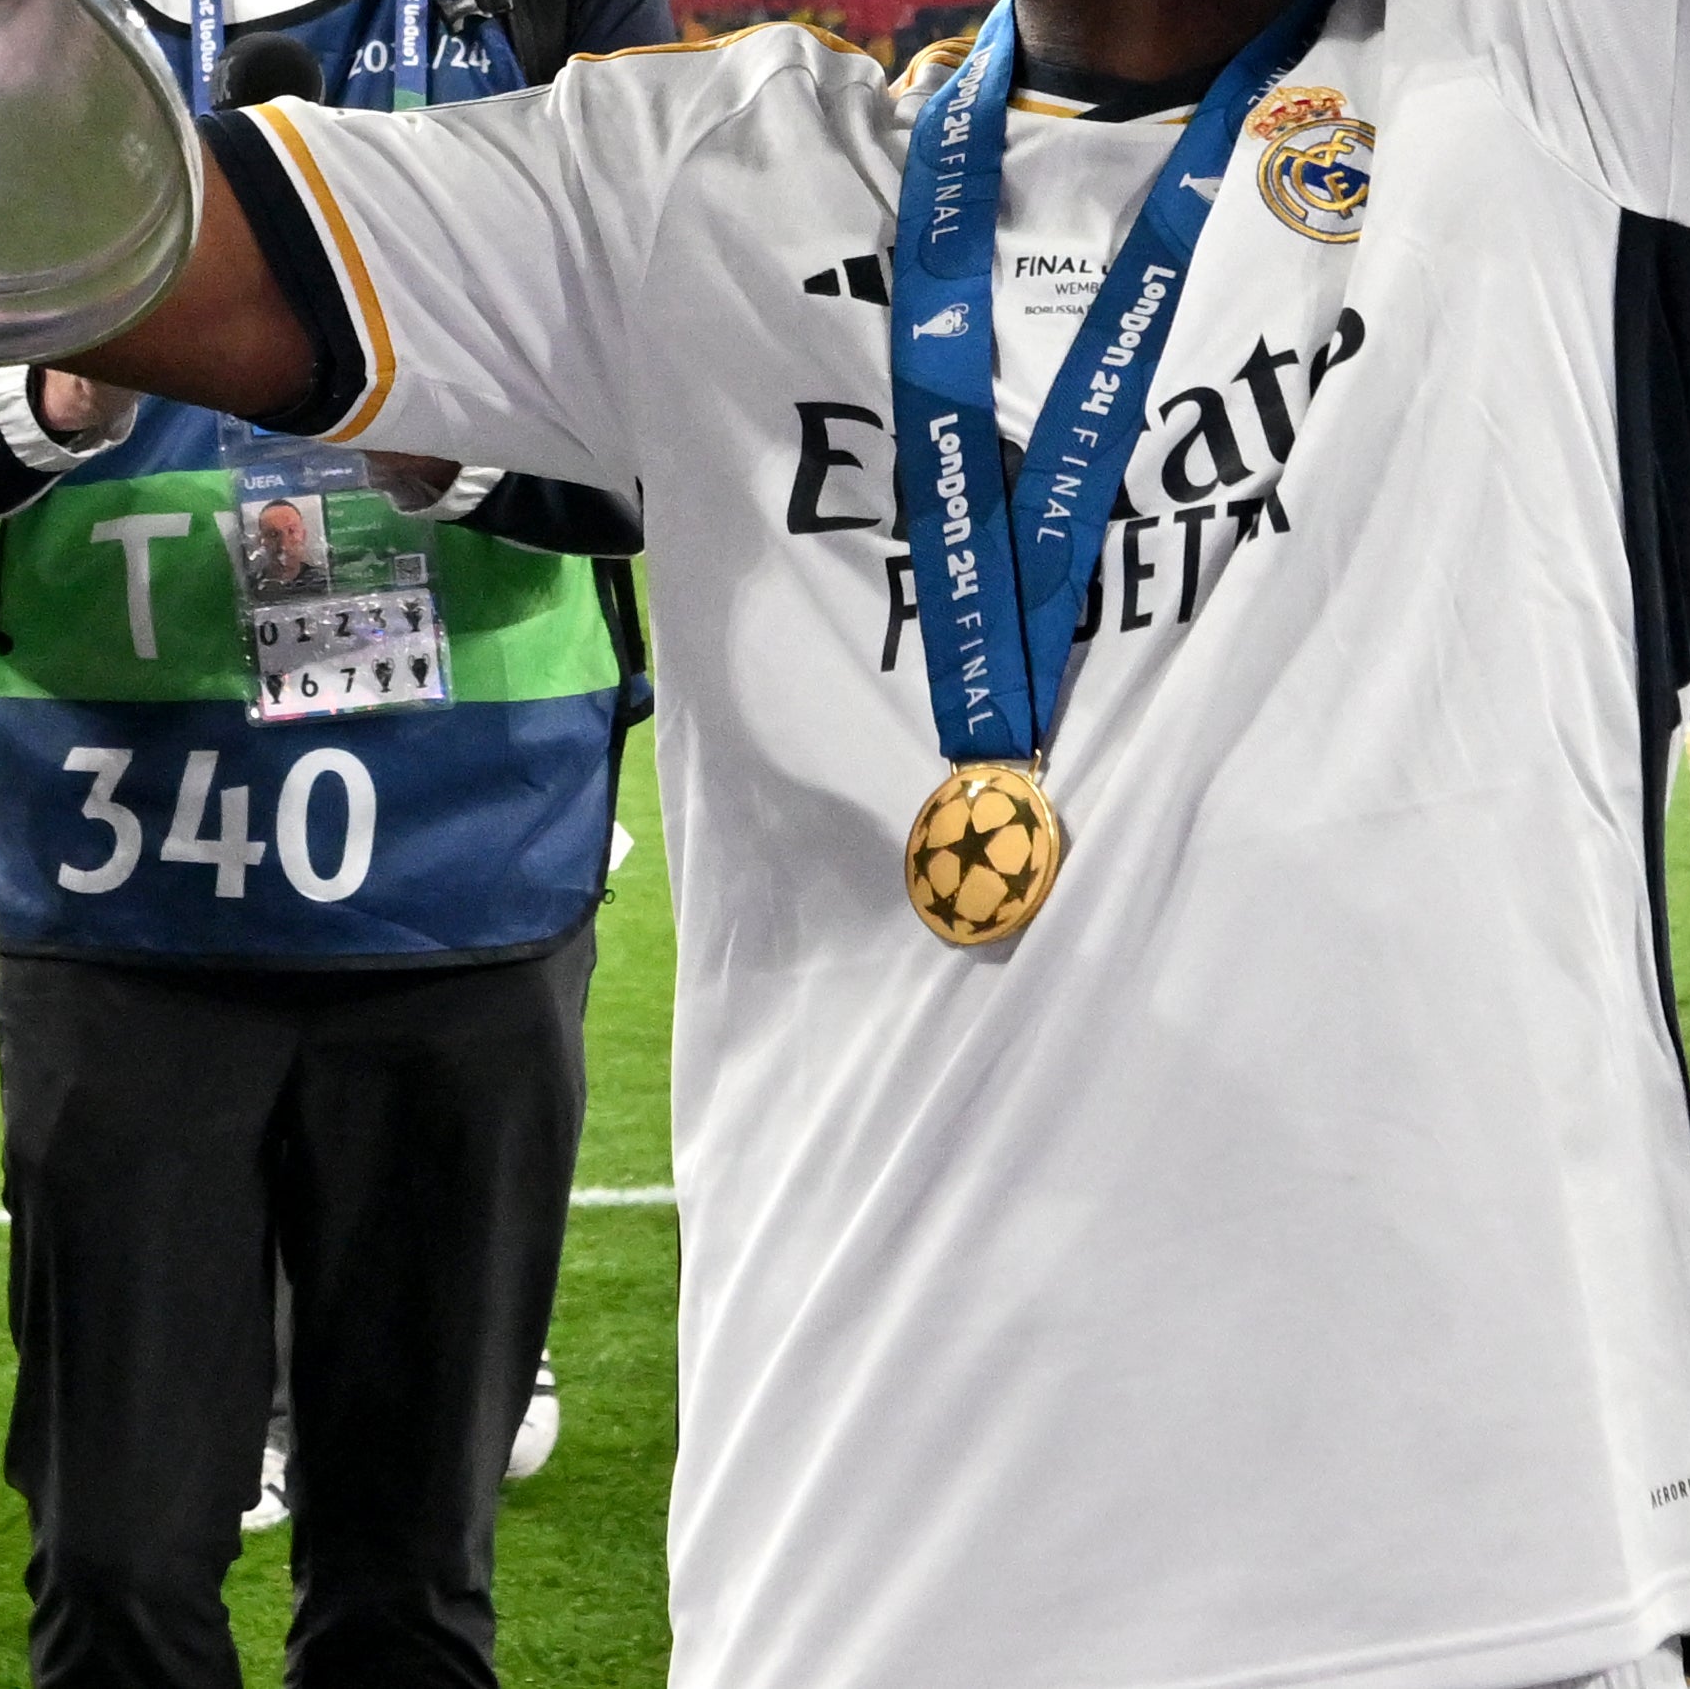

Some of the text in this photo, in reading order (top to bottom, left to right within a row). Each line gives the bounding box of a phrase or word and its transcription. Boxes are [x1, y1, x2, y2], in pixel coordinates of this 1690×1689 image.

[348, 36, 492, 81] 20/24
[941, 112, 971, 148] 24
[931, 153, 966, 244] FINAL
[1014, 255, 1093, 279] FINAL
[1054, 282, 1101, 296] WEMB
[1081, 370, 1121, 416] 24
[243, 474, 286, 491] UEFA
[1036, 427, 1099, 545] FINAL
[947, 551, 979, 601] 24
[260, 608, 386, 646] 0 1 2 3
[301, 667, 356, 698] 6 7
[956, 611, 994, 736] FINAL
[56, 745, 378, 903] 340
